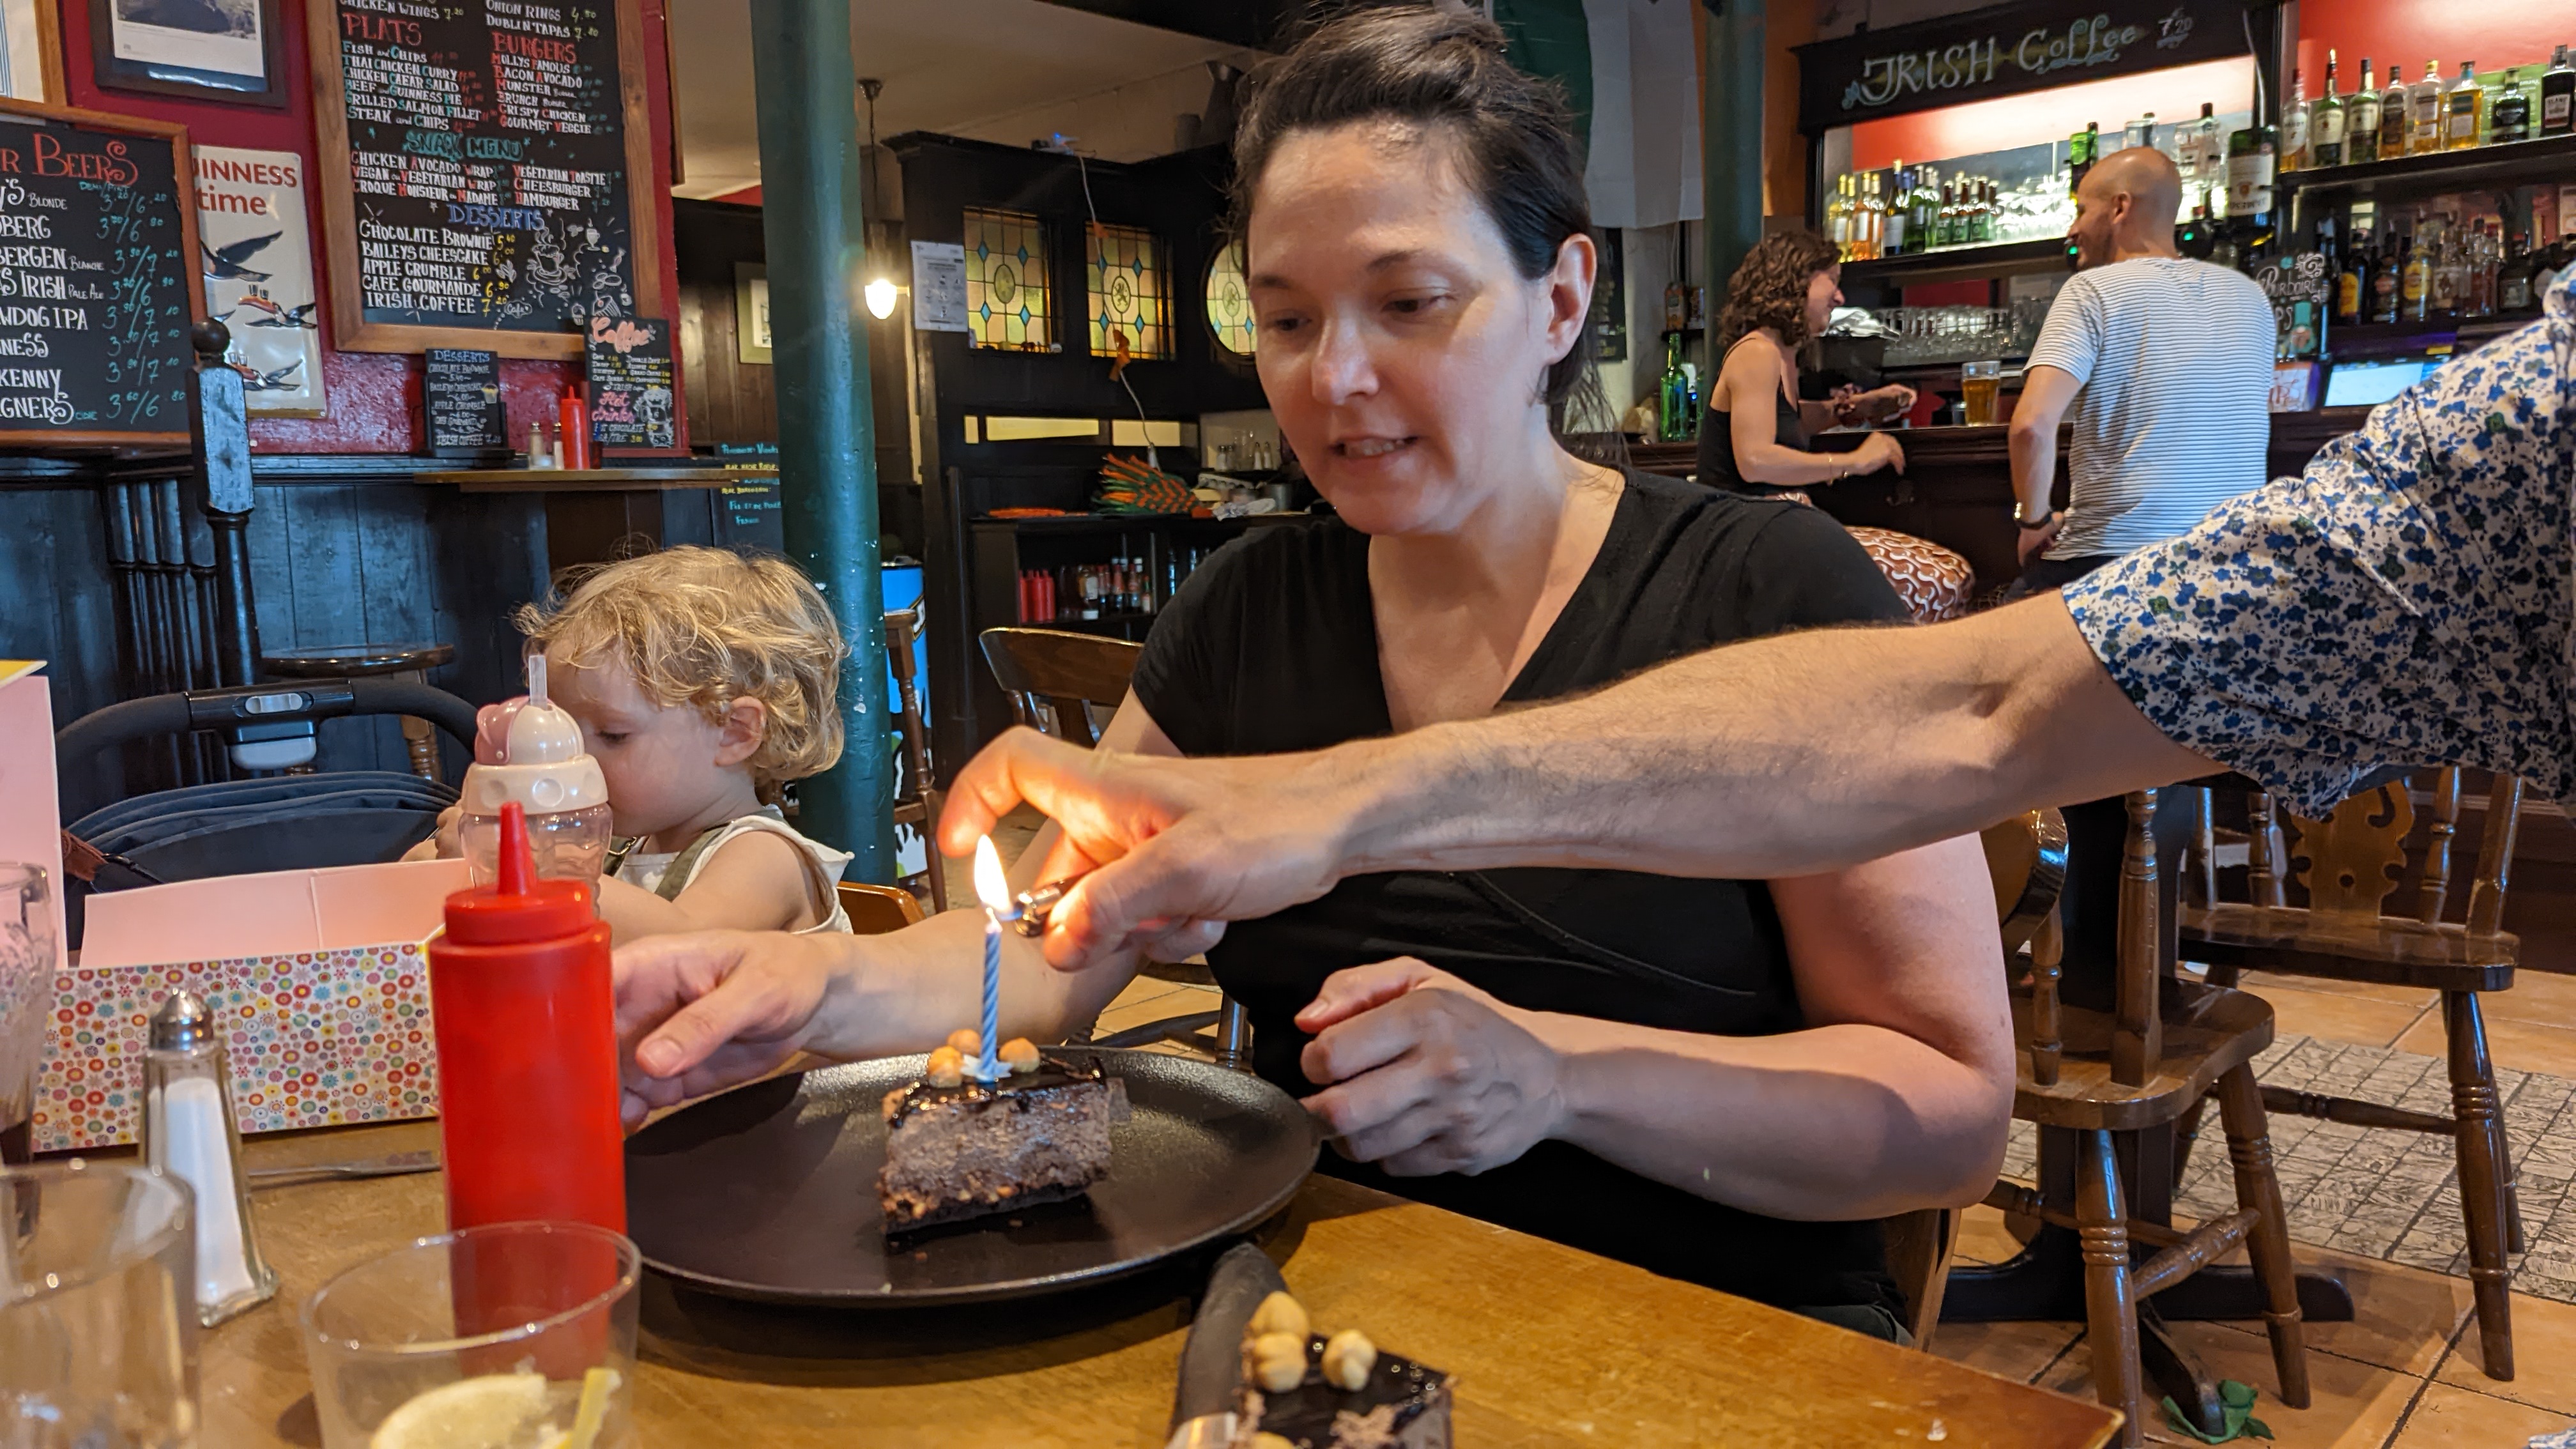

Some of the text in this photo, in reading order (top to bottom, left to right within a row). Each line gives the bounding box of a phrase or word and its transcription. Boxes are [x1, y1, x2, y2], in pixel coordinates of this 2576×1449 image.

[398, 3, 440, 19] WINGS
[485, 0, 522, 15] ONION
[525, 5, 561, 21] RINGS
[342, 12, 422, 46] PLATS
[485, 13, 531, 29] DUBLIN
[532, 22, 571, 38] TAPAS
[342, 40, 374, 54] FISH
[390, 45, 428, 63] CHIPS
[491, 31, 577, 65] BURGERS
[1858, 36, 1997, 105] IRISH
[2018, 15, 2136, 74] Coffee
[342, 54, 372, 68] THAI
[374, 57, 421, 77] CHICKEN
[421, 65, 458, 82] CURRY
[491, 52, 530, 68] MOLLYS
[530, 58, 571, 74] FAMOUS
[343, 66, 389, 85] CHICKEN
[424, 78, 459, 93] SALAD
[493, 65, 534, 82] BACON
[536, 72, 583, 89] AVOCADO
[496, 79, 552, 96] MUNSTER
[344, 79, 377, 94] BEEF
[388, 84, 443, 103] GUINNESS
[443, 93, 463, 106] PIE
[345, 89, 397, 109] GRILLED
[397, 98, 445, 117] SALMON
[446, 105, 483, 121] FILLET
[496, 90, 539, 107] BRUNCH
[347, 105, 392, 125] STEAK
[414, 114, 450, 131] CHIPS
[497, 103, 540, 119] CRISPY
[542, 108, 586, 123] CHICKEN
[499, 114, 553, 132] GOURMET
[553, 121, 592, 135] VEGGIE
[32, 132, 139, 186] BEERS
[466, 136, 524, 162] MENU
[351, 150, 408, 171] CHICKEN
[410, 156, 461, 174] AVOCADO
[462, 163, 494, 179] WRAP
[512, 164, 569, 180] VEGETARIAN
[568, 170, 607, 187] TOASTIE
[351, 165, 390, 181] VEGAN
[399, 170, 466, 188] VEGETARIAN
[466, 179, 497, 192] WRAP
[514, 178, 592, 199] CHEESBURGER
[27, 192, 68, 210] BLONDE
[197, 186, 268, 216] time
[351, 178, 397, 196] CROQUE
[397, 183, 450, 202] MONSIEUR
[456, 189, 498, 206] MADAME
[514, 191, 580, 211] HAMBURGER
[0, 215, 52, 240] BERG
[446, 203, 546, 231] DESSERTS
[359, 219, 440, 245] CHOCOLATE
[442, 227, 493, 250] BROWNIE
[361, 240, 416, 261] BAILEYS
[418, 246, 489, 266] CHEESCAKE
[363, 257, 402, 276] APPLE
[404, 261, 466, 281] CRUMBLE
[19, 270, 68, 300] IRISH
[68, 284, 88, 300] PALE
[362, 274, 399, 292] CAFE
[402, 277, 482, 297] GOURMANDE
[367, 292, 413, 309] IRISH
[419, 294, 477, 314] COFFEE
[0, 332, 49, 358] NESS
[434, 350, 491, 363] DESSERTS
[0, 392, 75, 425] GNERS
